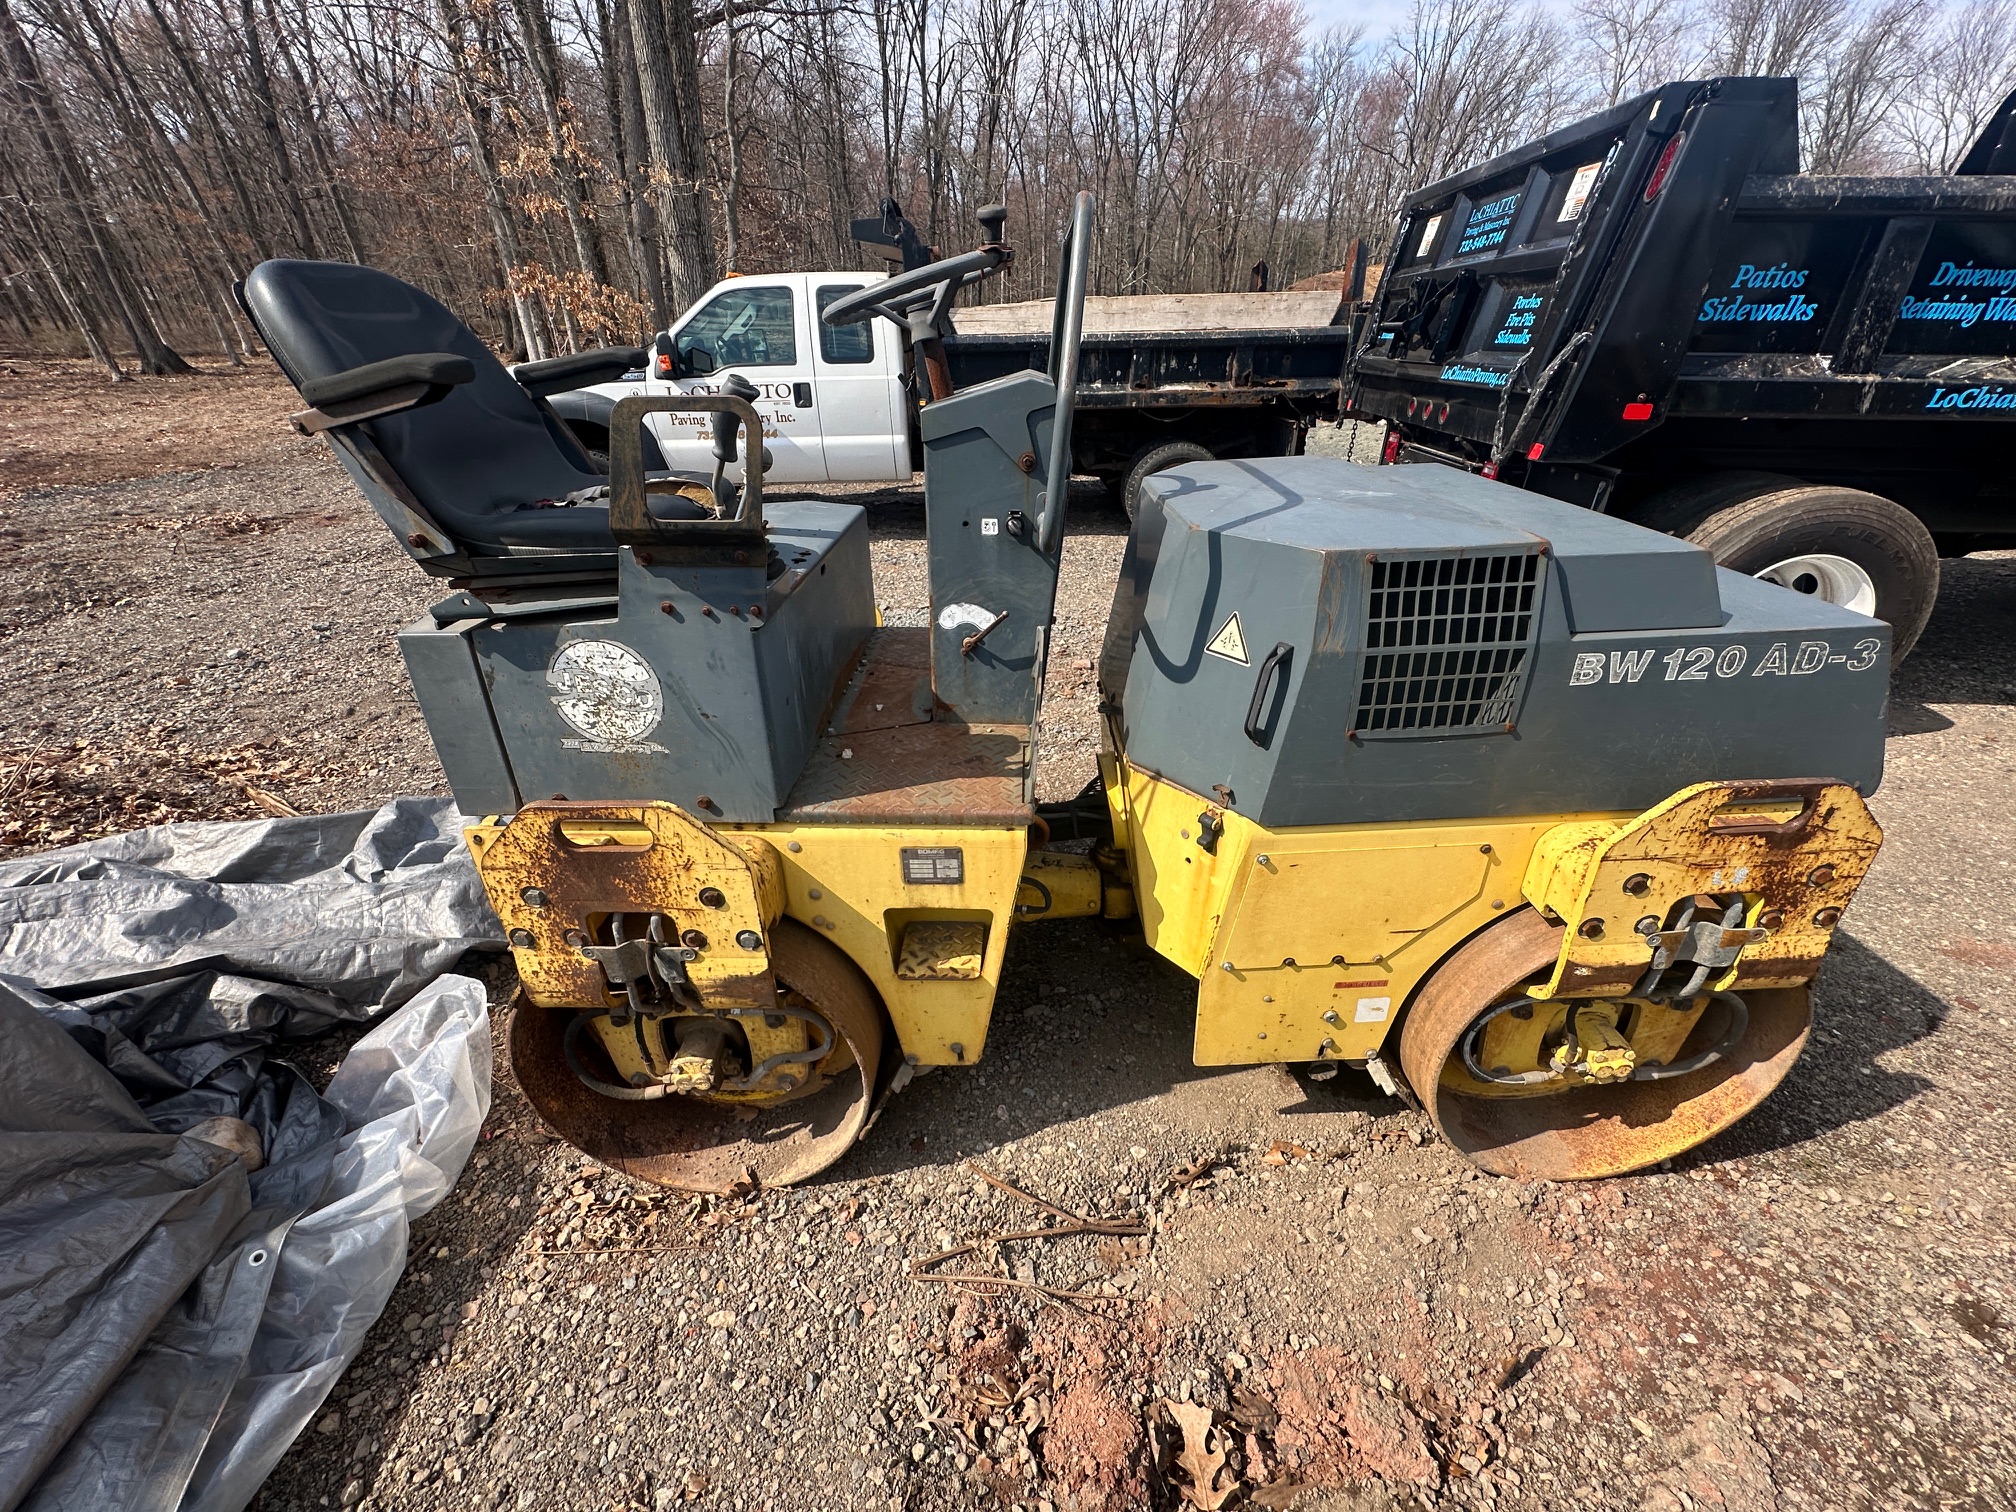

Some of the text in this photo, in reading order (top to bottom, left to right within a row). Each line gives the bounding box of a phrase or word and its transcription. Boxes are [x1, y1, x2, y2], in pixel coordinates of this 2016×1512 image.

[1730, 262, 1810, 289] Patios
[1512, 293, 1544, 309] Porches
[1698, 294, 1819, 322] Sidewalks
[1901, 294, 1986, 328] Retaining
[1505, 311, 1536, 327] Fire Pits
[1495, 329, 1532, 345] Sidewalks
[670, 413, 706, 427] Paving
[775, 410, 796, 423] Inc.
[1569, 638, 1882, 686] BW 120 AD-3
